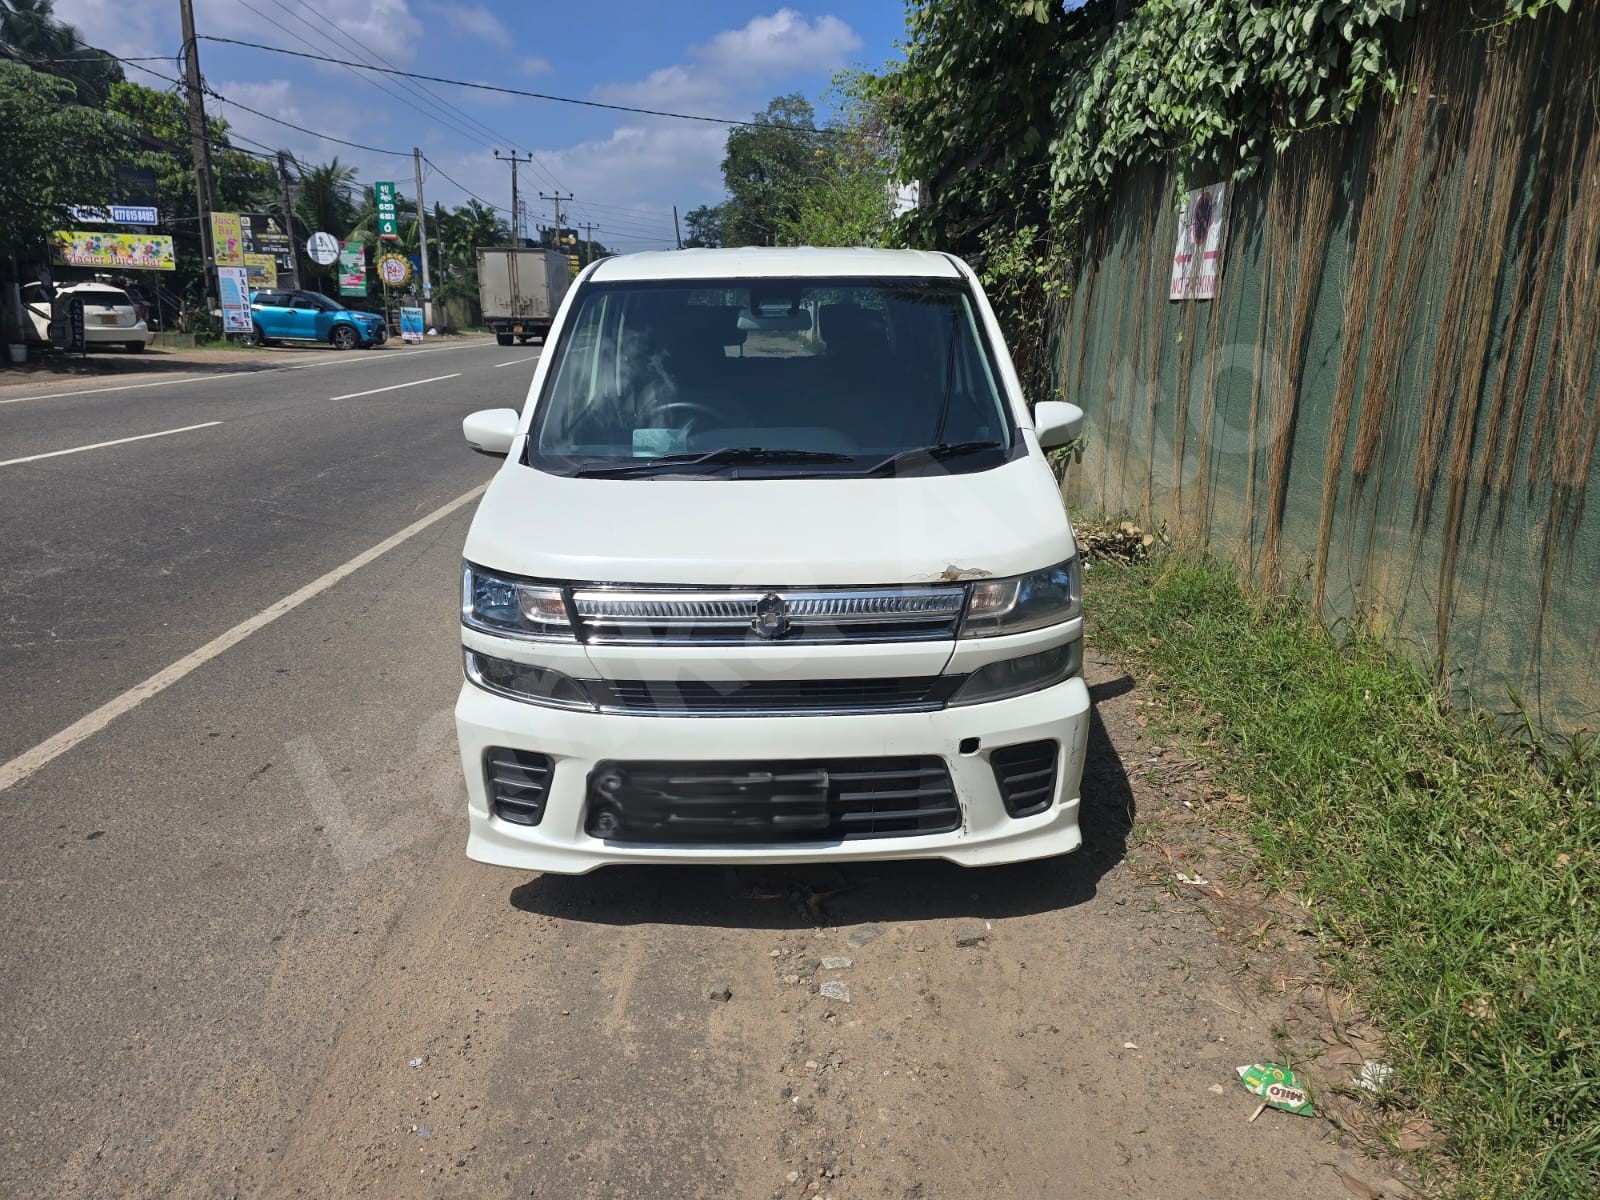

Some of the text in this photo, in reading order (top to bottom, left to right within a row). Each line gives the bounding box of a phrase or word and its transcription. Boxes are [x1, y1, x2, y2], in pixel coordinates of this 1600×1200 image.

[214, 215, 236, 225] Juice
[218, 225, 233, 235] Bar
[63, 252, 161, 267] Glacier Juice Bar
[1172, 274, 1216, 293] NO PRKIN
[239, 269, 251, 327] LAUNDRY
[1270, 1086, 1304, 1102] MILO
